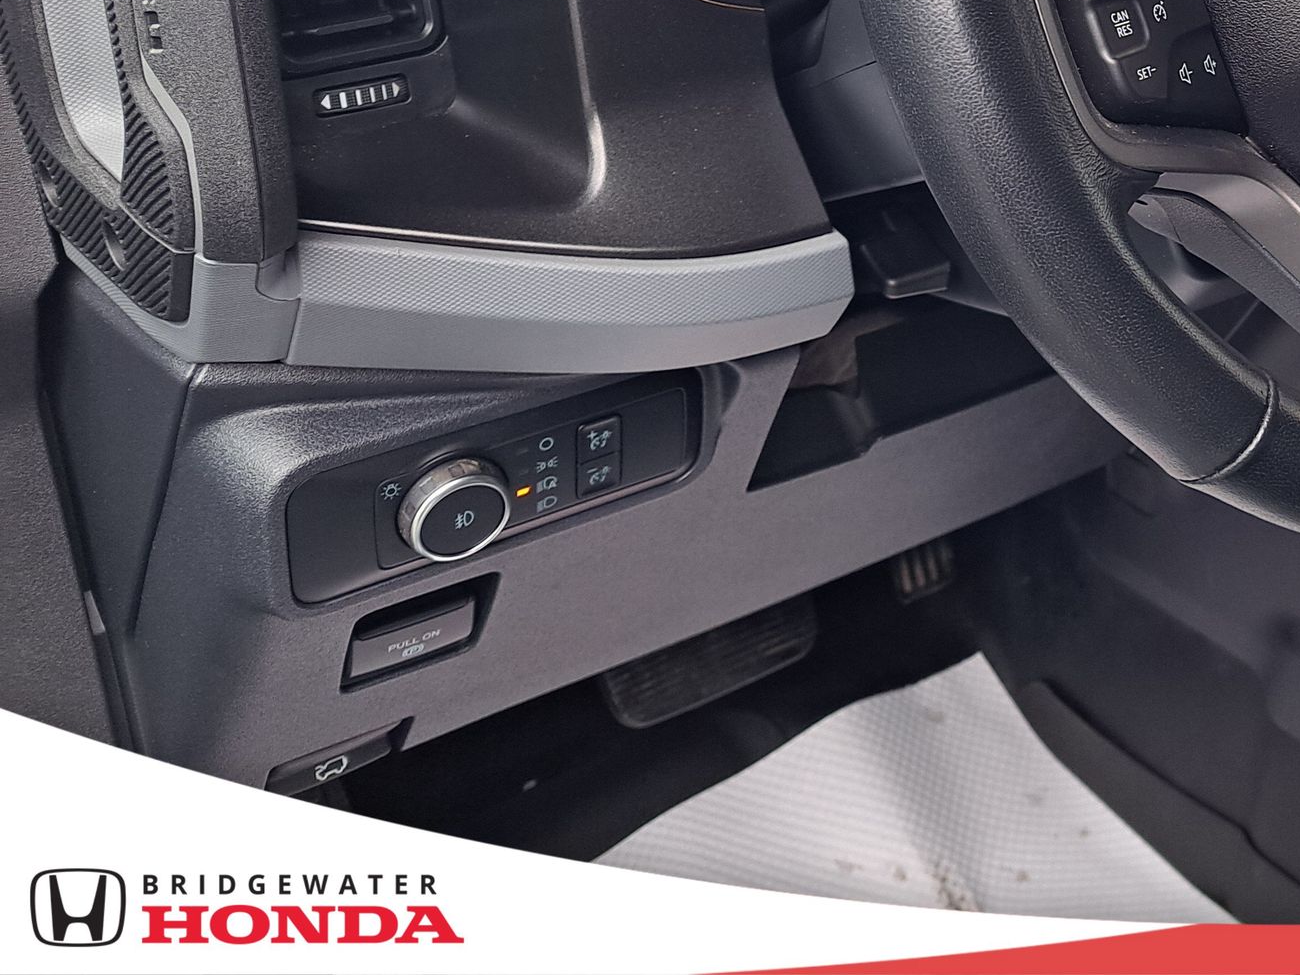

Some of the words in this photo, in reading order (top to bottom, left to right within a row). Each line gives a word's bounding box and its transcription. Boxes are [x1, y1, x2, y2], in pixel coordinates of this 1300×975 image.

[1110, 9, 1129, 24] CAN
[1116, 26, 1134, 38] RES
[1137, 66, 1157, 81] SET-
[388, 638, 420, 653] PULL
[421, 629, 441, 642] ON
